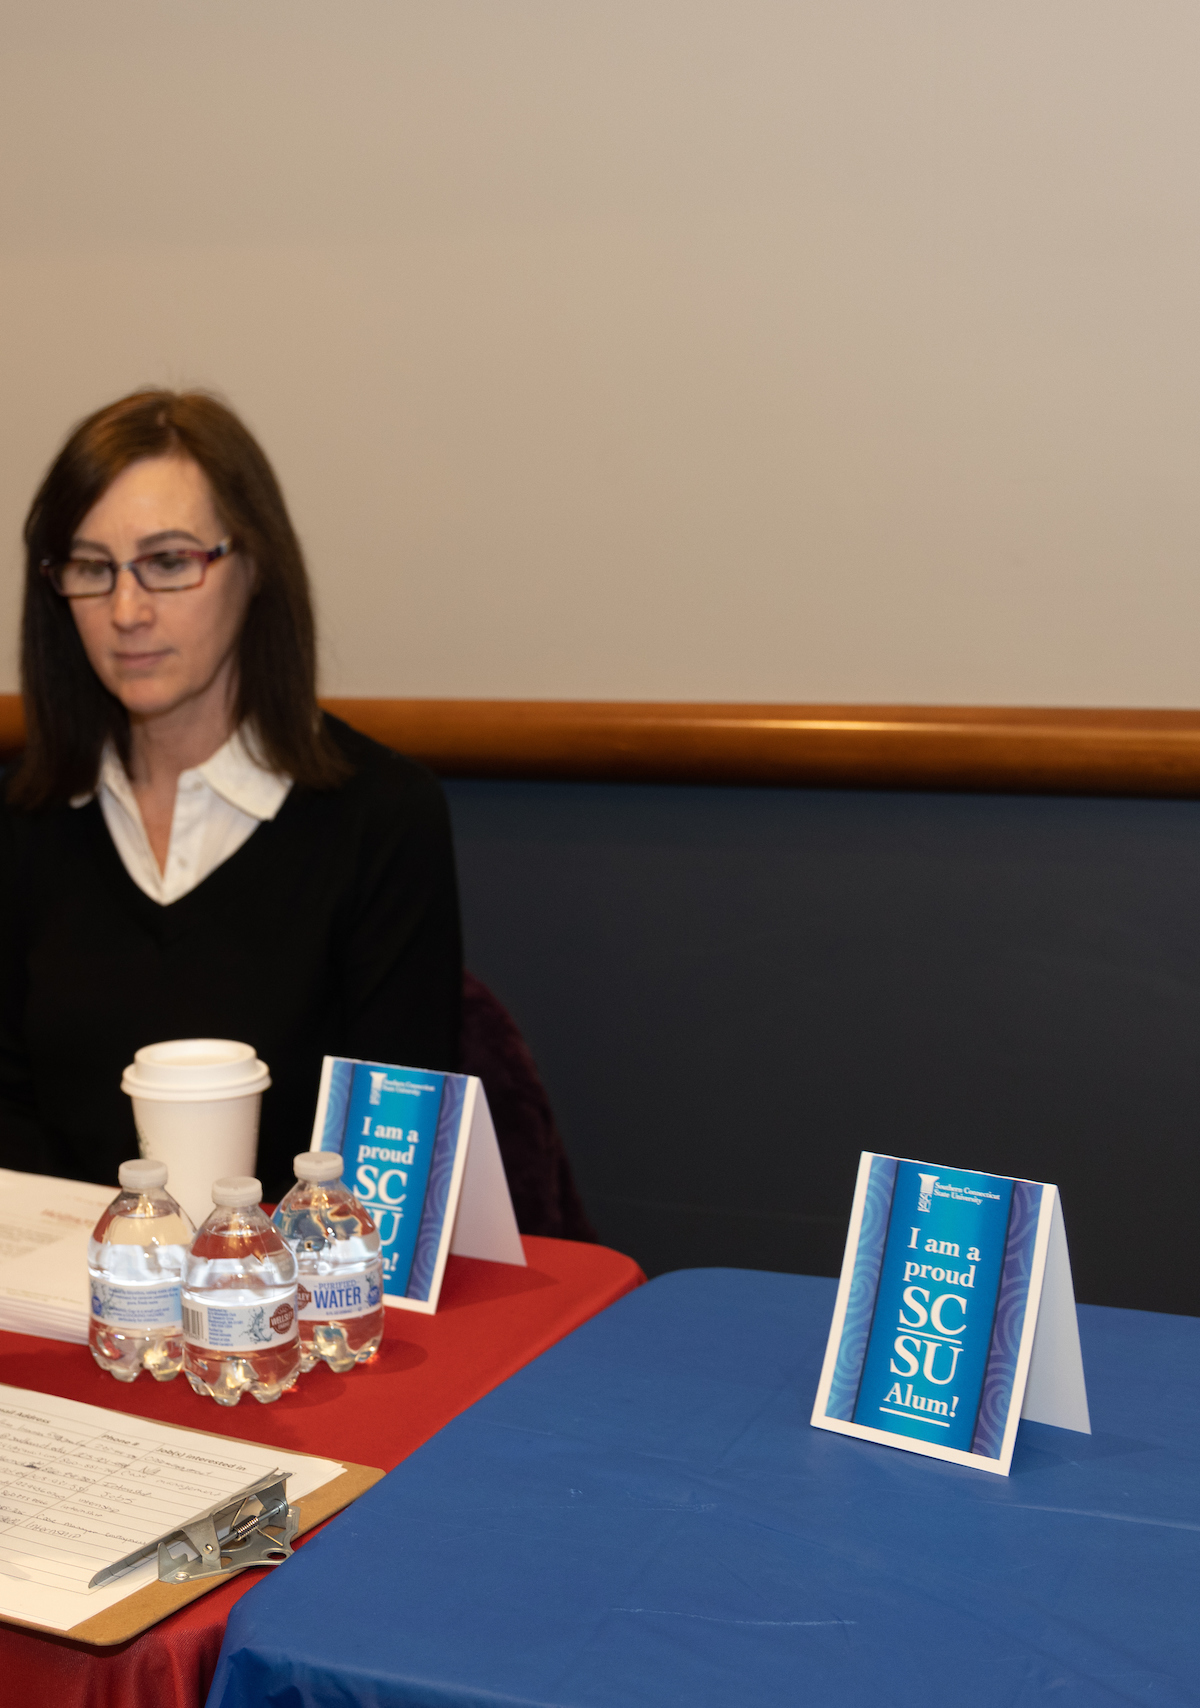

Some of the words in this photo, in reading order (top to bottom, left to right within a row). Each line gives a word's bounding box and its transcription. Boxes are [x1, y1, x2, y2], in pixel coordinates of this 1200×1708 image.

[362, 1116, 372, 1136] I
[374, 1124, 403, 1141] am
[406, 1129, 419, 1144] a
[357, 1144, 416, 1165] proud
[353, 1164, 408, 1205] SC
[934, 1182, 962, 1193] Southern
[964, 1187, 1000, 1200] Connecticut
[934, 1189, 950, 1198] State
[951, 1192, 983, 1206] University
[368, 1208, 404, 1246] U
[907, 1227, 922, 1249] I
[924, 1238, 960, 1258] am
[966, 1246, 981, 1262] a
[318, 1280, 356, 1290] PURIFIED
[902, 1261, 976, 1288] proud
[314, 1286, 362, 1309] WATER
[899, 1286, 968, 1336] SC
[890, 1335, 964, 1385] SU
[883, 1382, 960, 1418] Alum!
[16, 1412, 50, 1424] Address
[102, 1434, 130, 1446] Phone
[186, 1453, 236, 1470] interested
